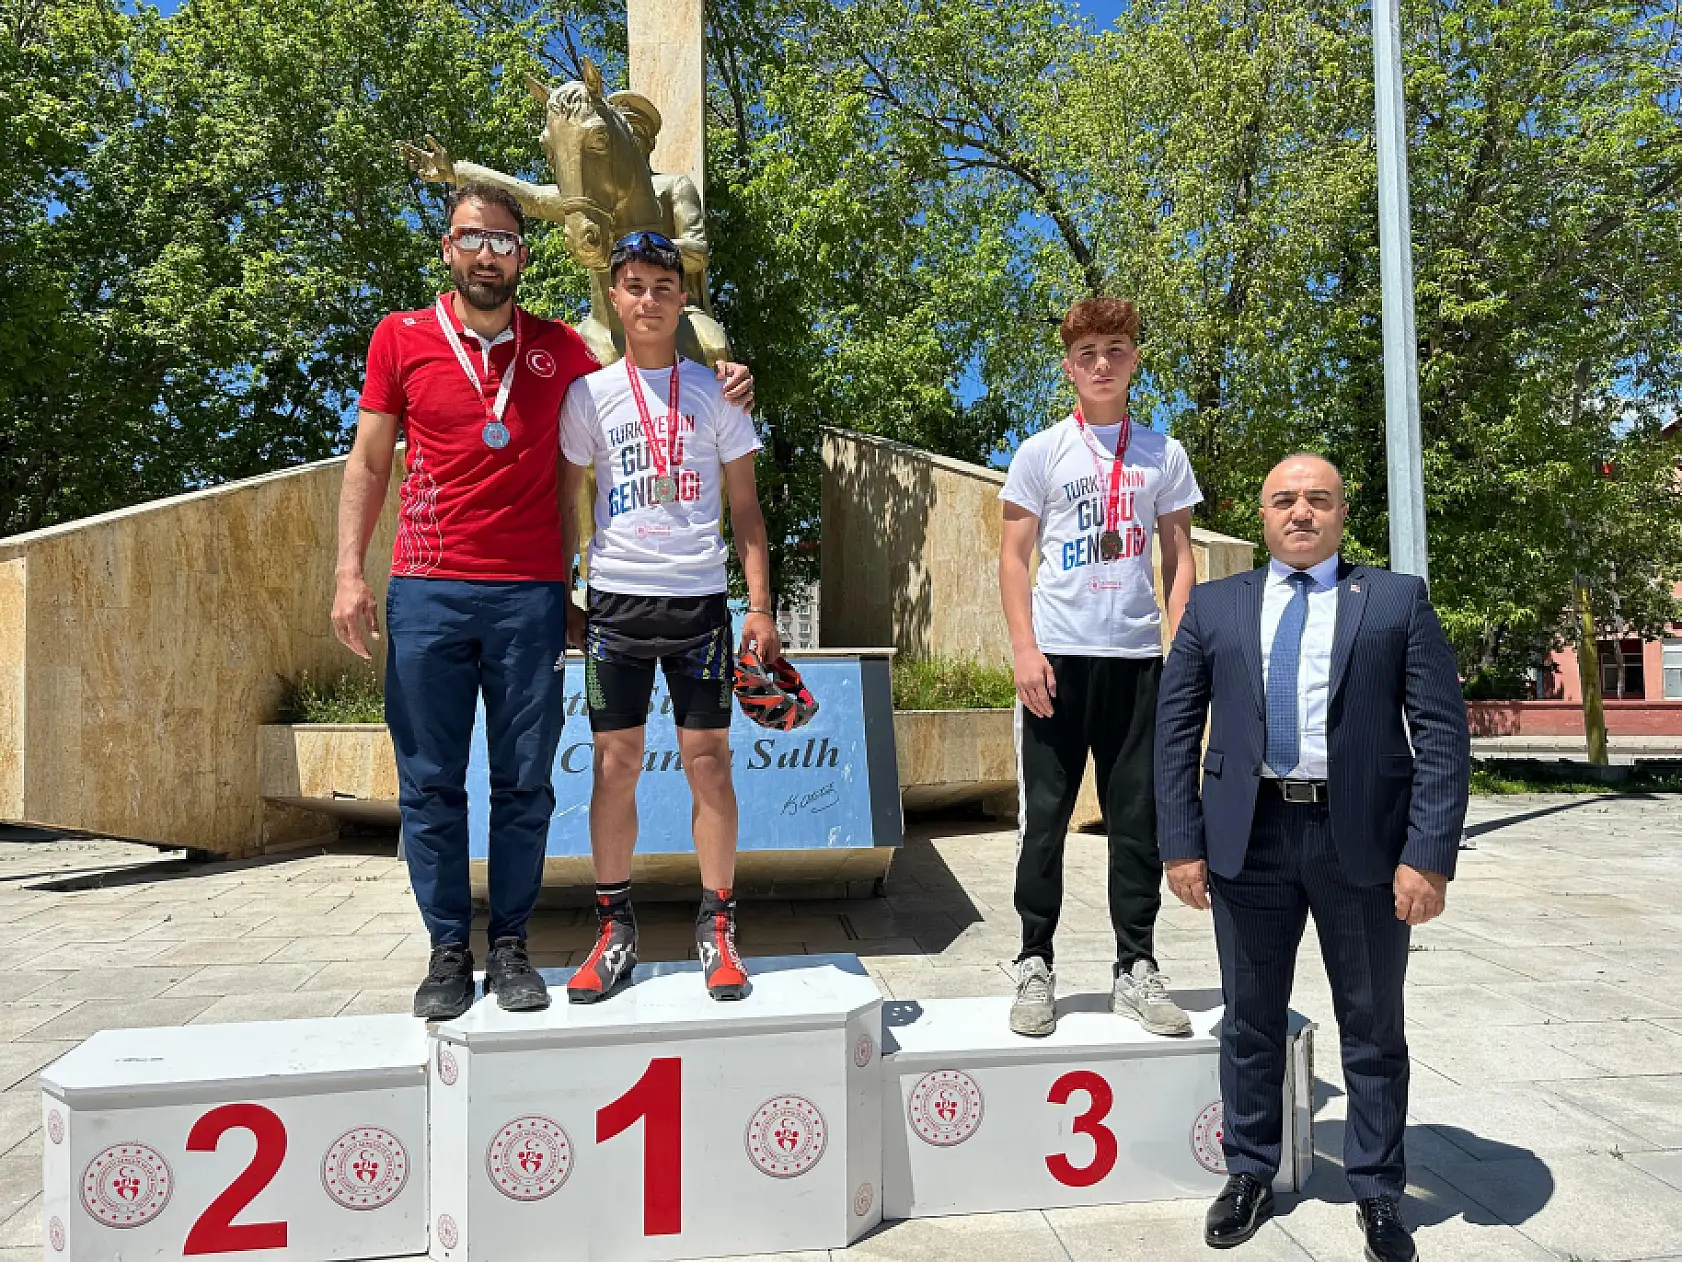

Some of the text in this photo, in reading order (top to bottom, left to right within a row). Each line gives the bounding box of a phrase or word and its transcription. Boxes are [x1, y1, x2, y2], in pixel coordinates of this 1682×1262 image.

[1078, 491, 1135, 530] GÜÜ
[182, 1103, 288, 1256] 2
[596, 1056, 682, 1236] 1
[1045, 1070, 1118, 1188] 3
